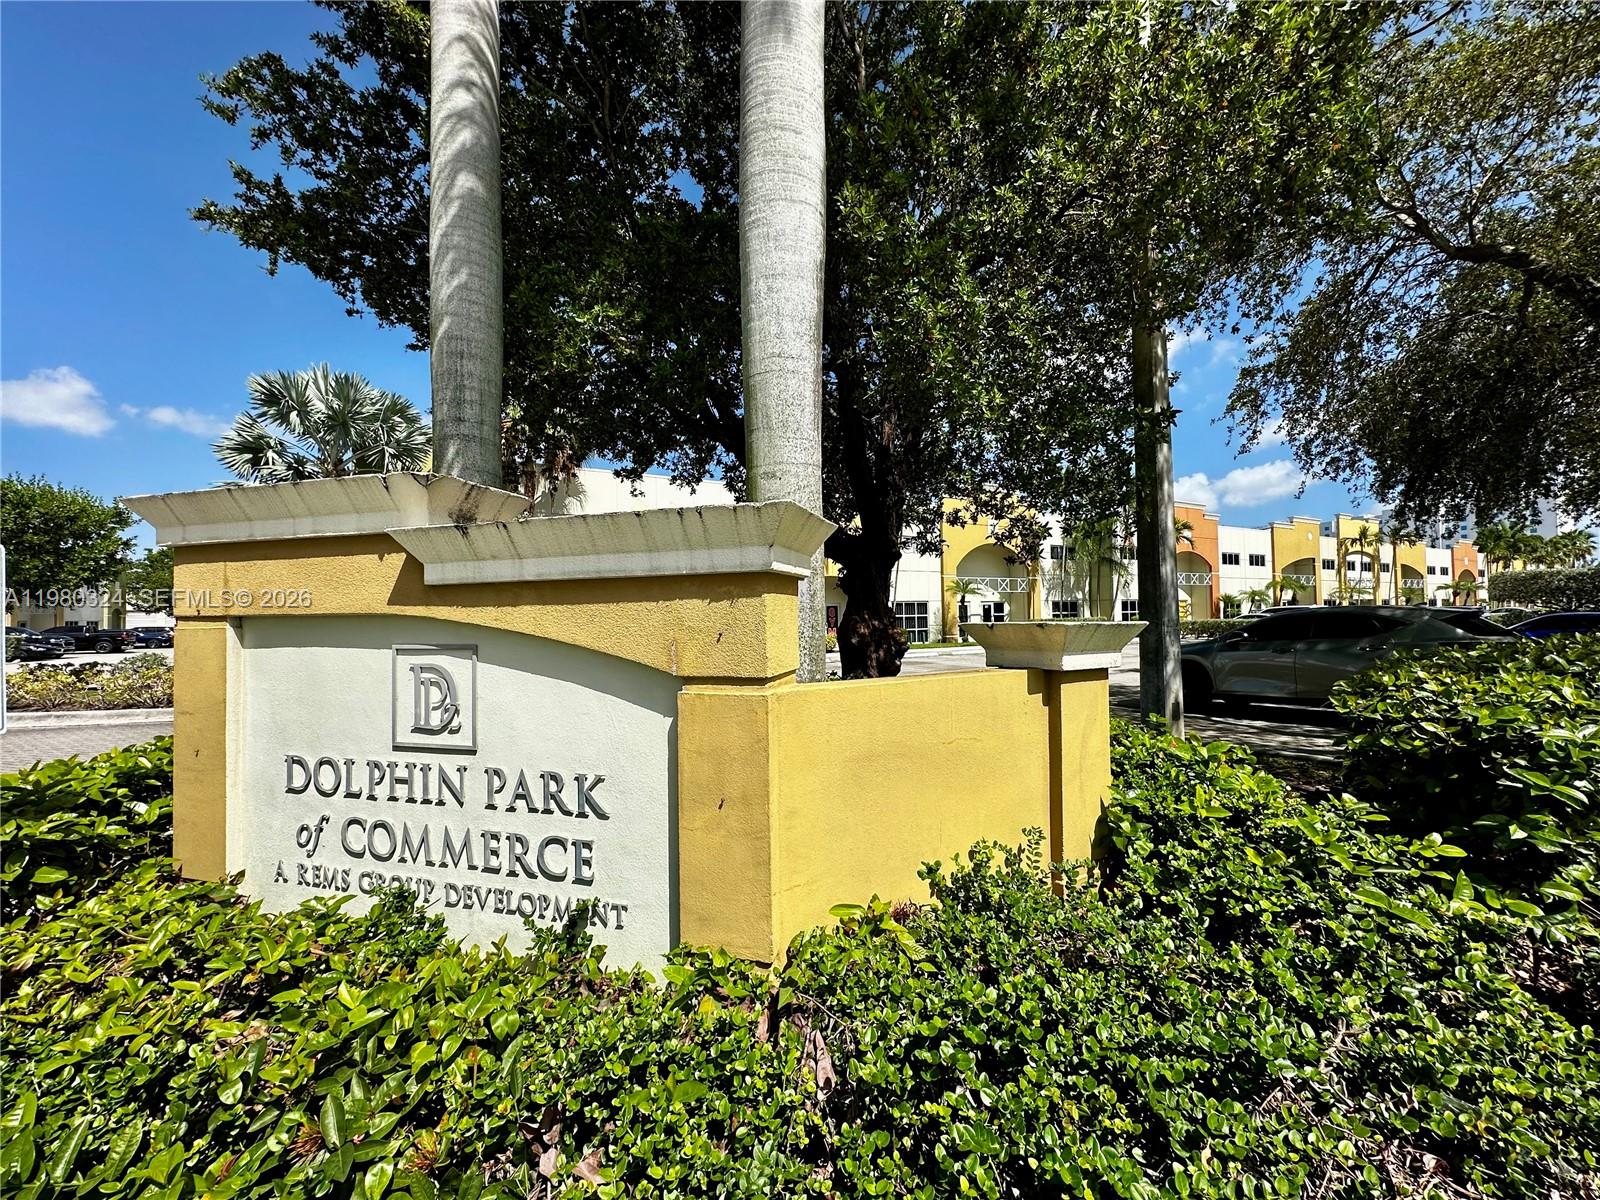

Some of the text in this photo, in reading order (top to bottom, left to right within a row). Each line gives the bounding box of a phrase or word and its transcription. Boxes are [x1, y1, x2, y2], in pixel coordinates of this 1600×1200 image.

[284, 755, 610, 820] DOLPHIN PARK
[296, 814, 595, 886] of COMMERCE
[273, 859, 289, 884] A
[296, 863, 351, 892] REMS
[444, 882, 628, 930] DEVELOPMNT
